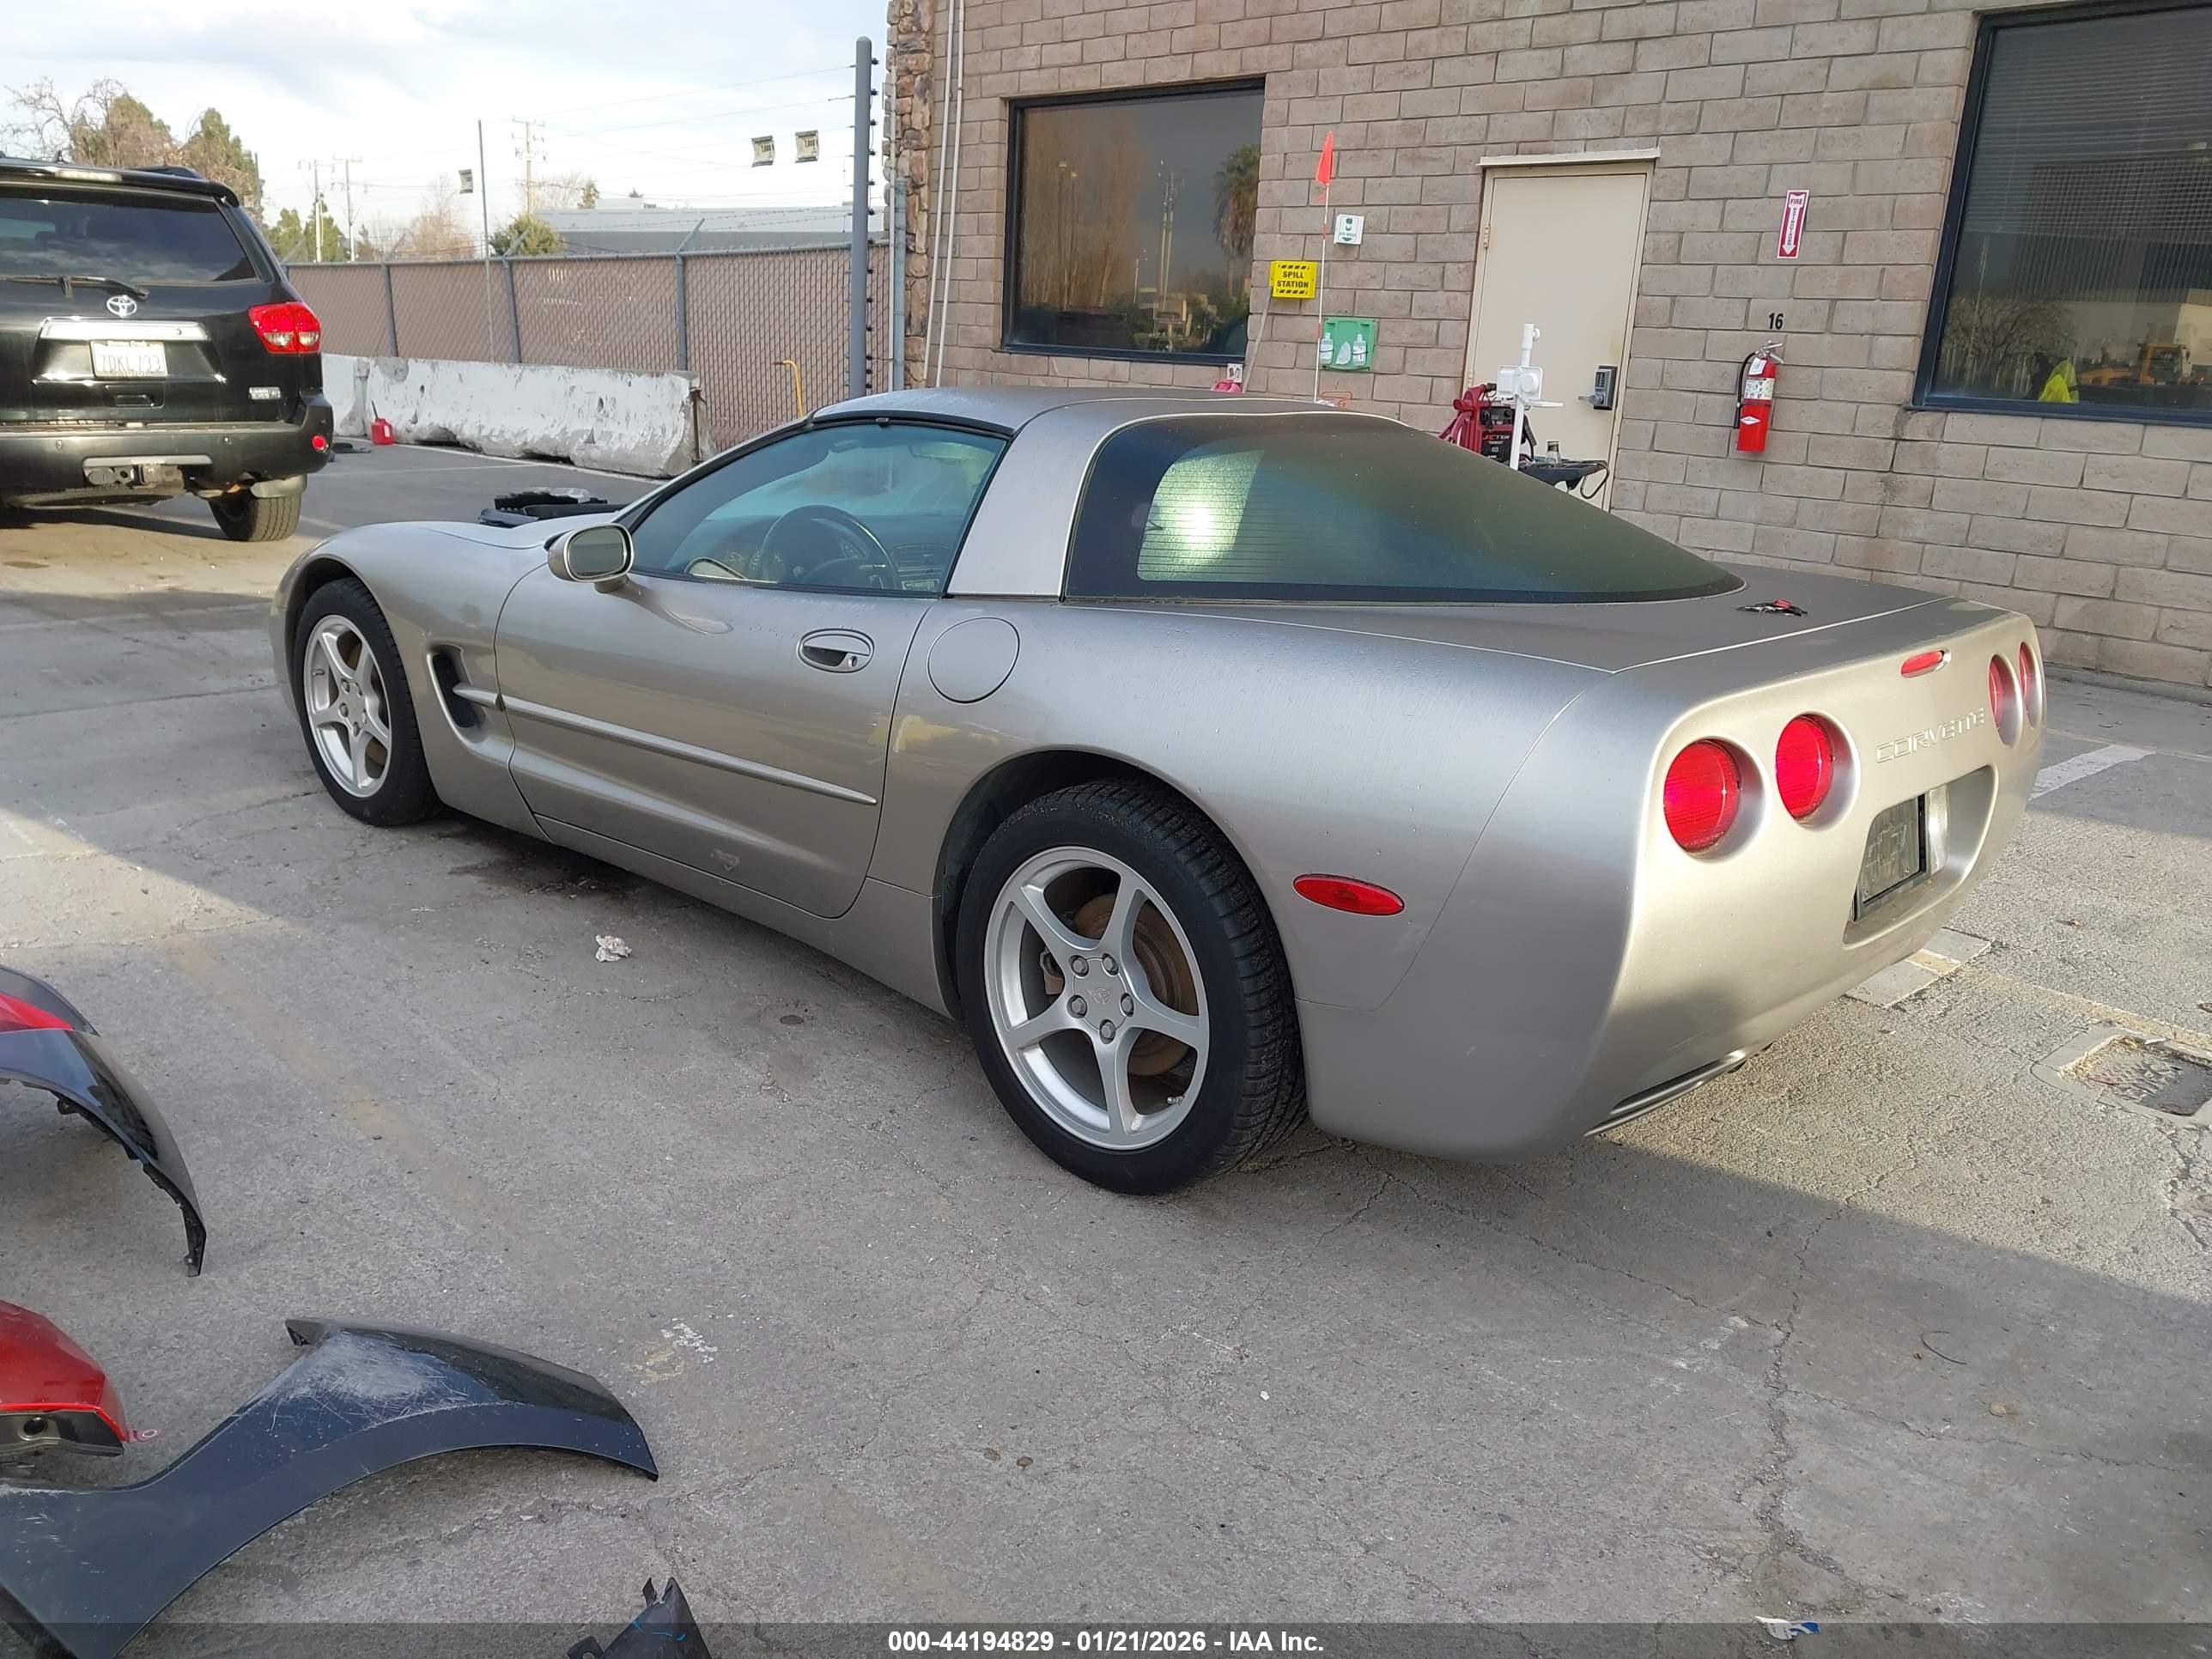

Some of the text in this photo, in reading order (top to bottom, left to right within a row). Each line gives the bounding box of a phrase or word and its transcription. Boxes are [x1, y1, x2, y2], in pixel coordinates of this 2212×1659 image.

[1282, 270, 1304, 279] SPILL
[1277, 280, 1310, 289] STATION
[1768, 312, 1784, 331] 16
[1875, 707, 1985, 765] CORVETTE
